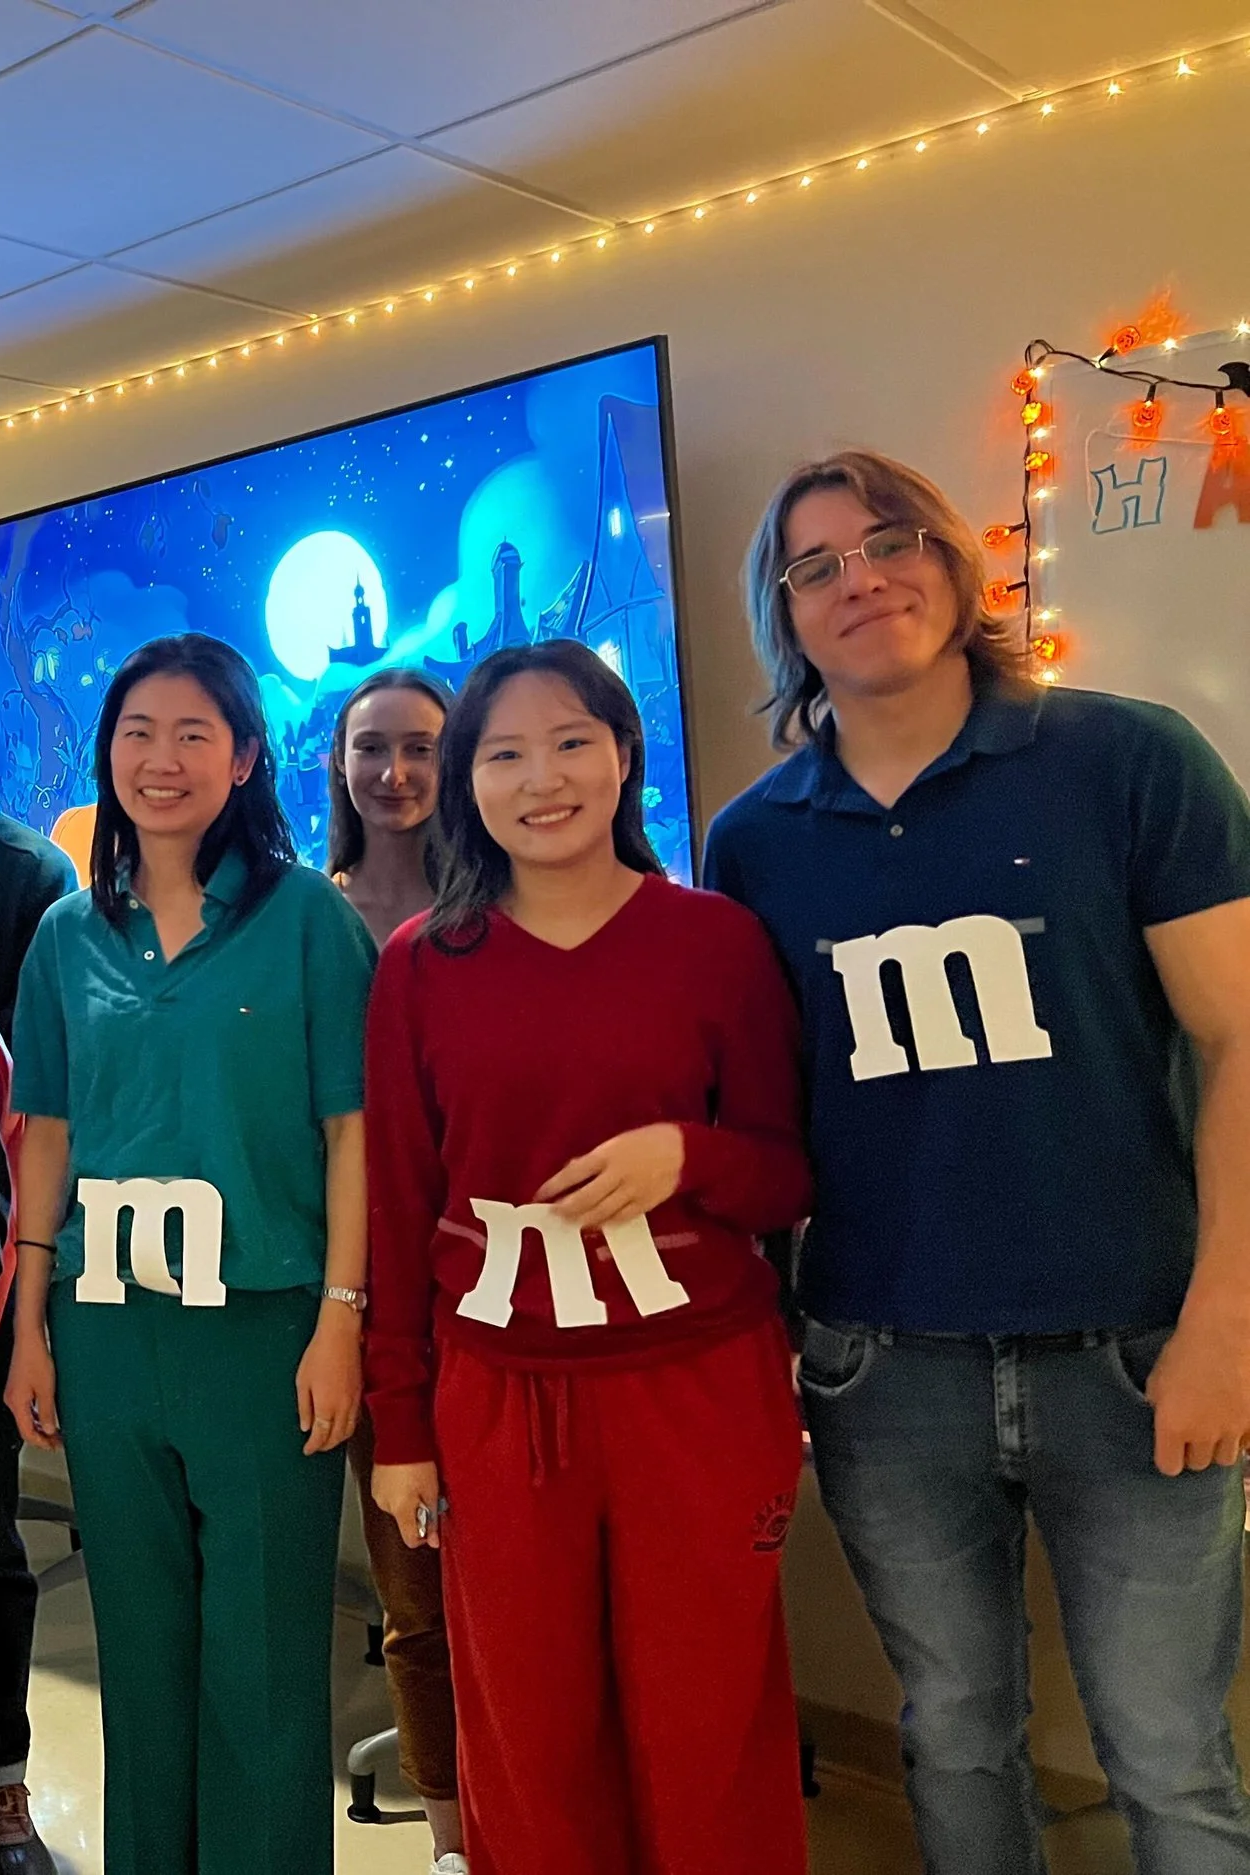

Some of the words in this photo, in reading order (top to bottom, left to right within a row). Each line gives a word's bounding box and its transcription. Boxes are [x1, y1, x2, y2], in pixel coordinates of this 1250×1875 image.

[832, 914, 1053, 1081] m
[76, 1178, 227, 1306] m
[456, 1198, 691, 1328] m
